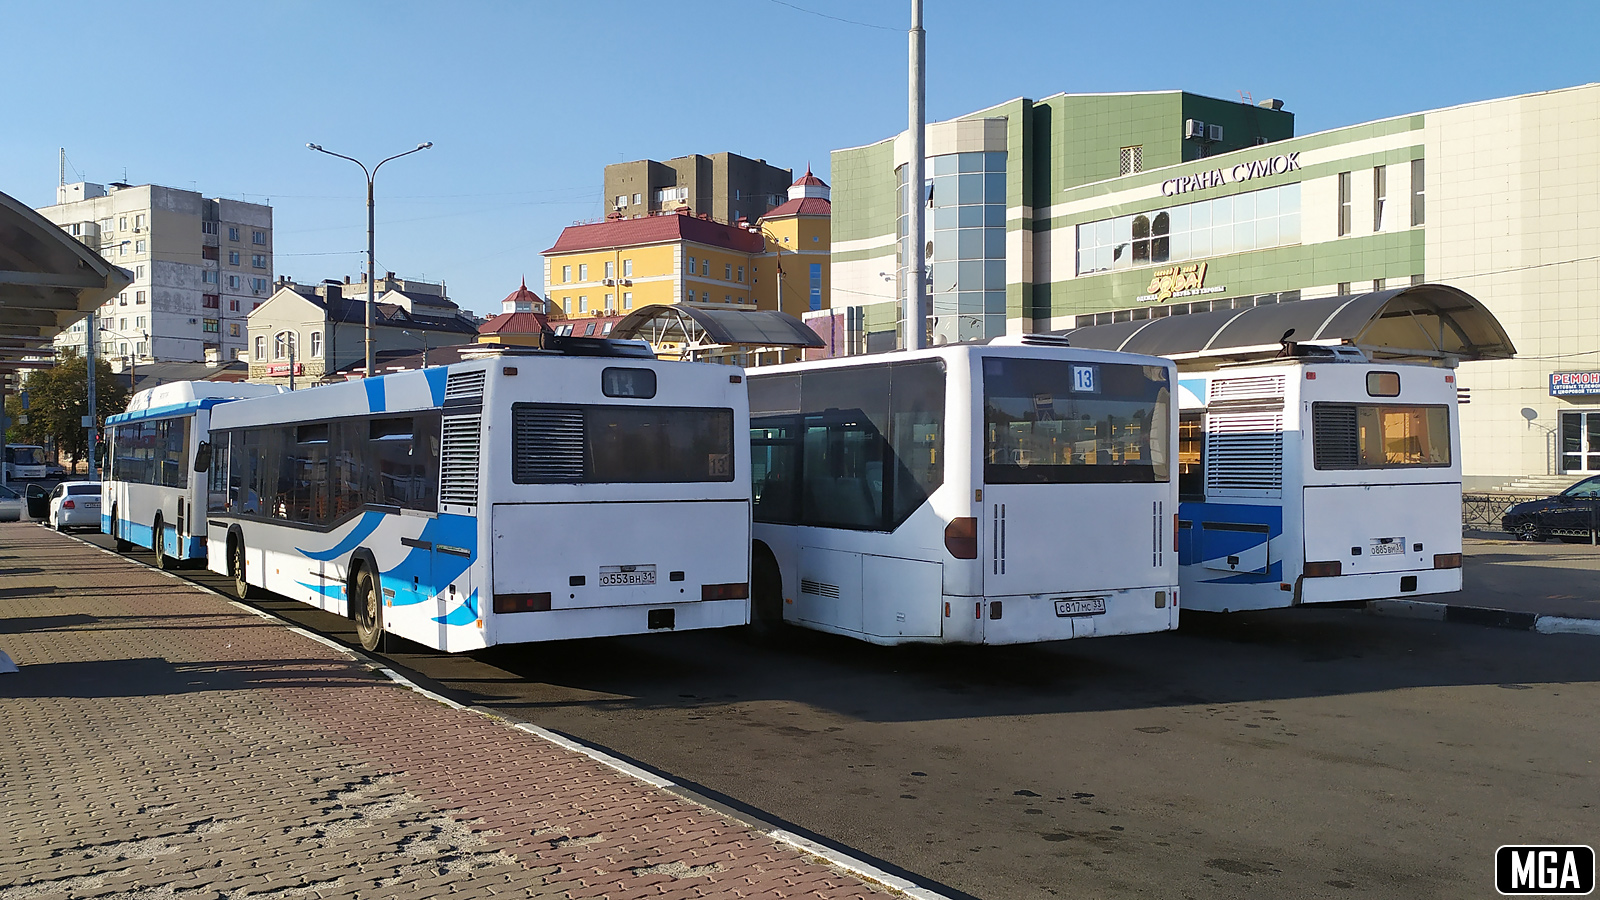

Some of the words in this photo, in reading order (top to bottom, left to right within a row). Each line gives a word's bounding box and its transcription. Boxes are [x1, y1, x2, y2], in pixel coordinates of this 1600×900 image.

[1161, 168, 1226, 197] СТРАНА
[1232, 152, 1302, 183] СУМОК
[1077, 370, 1092, 388] 13
[1552, 373, 1600, 384] РЕМОН
[710, 458, 725, 474] 13
[642, 572, 653, 581] 31
[1093, 600, 1102, 608] 33
